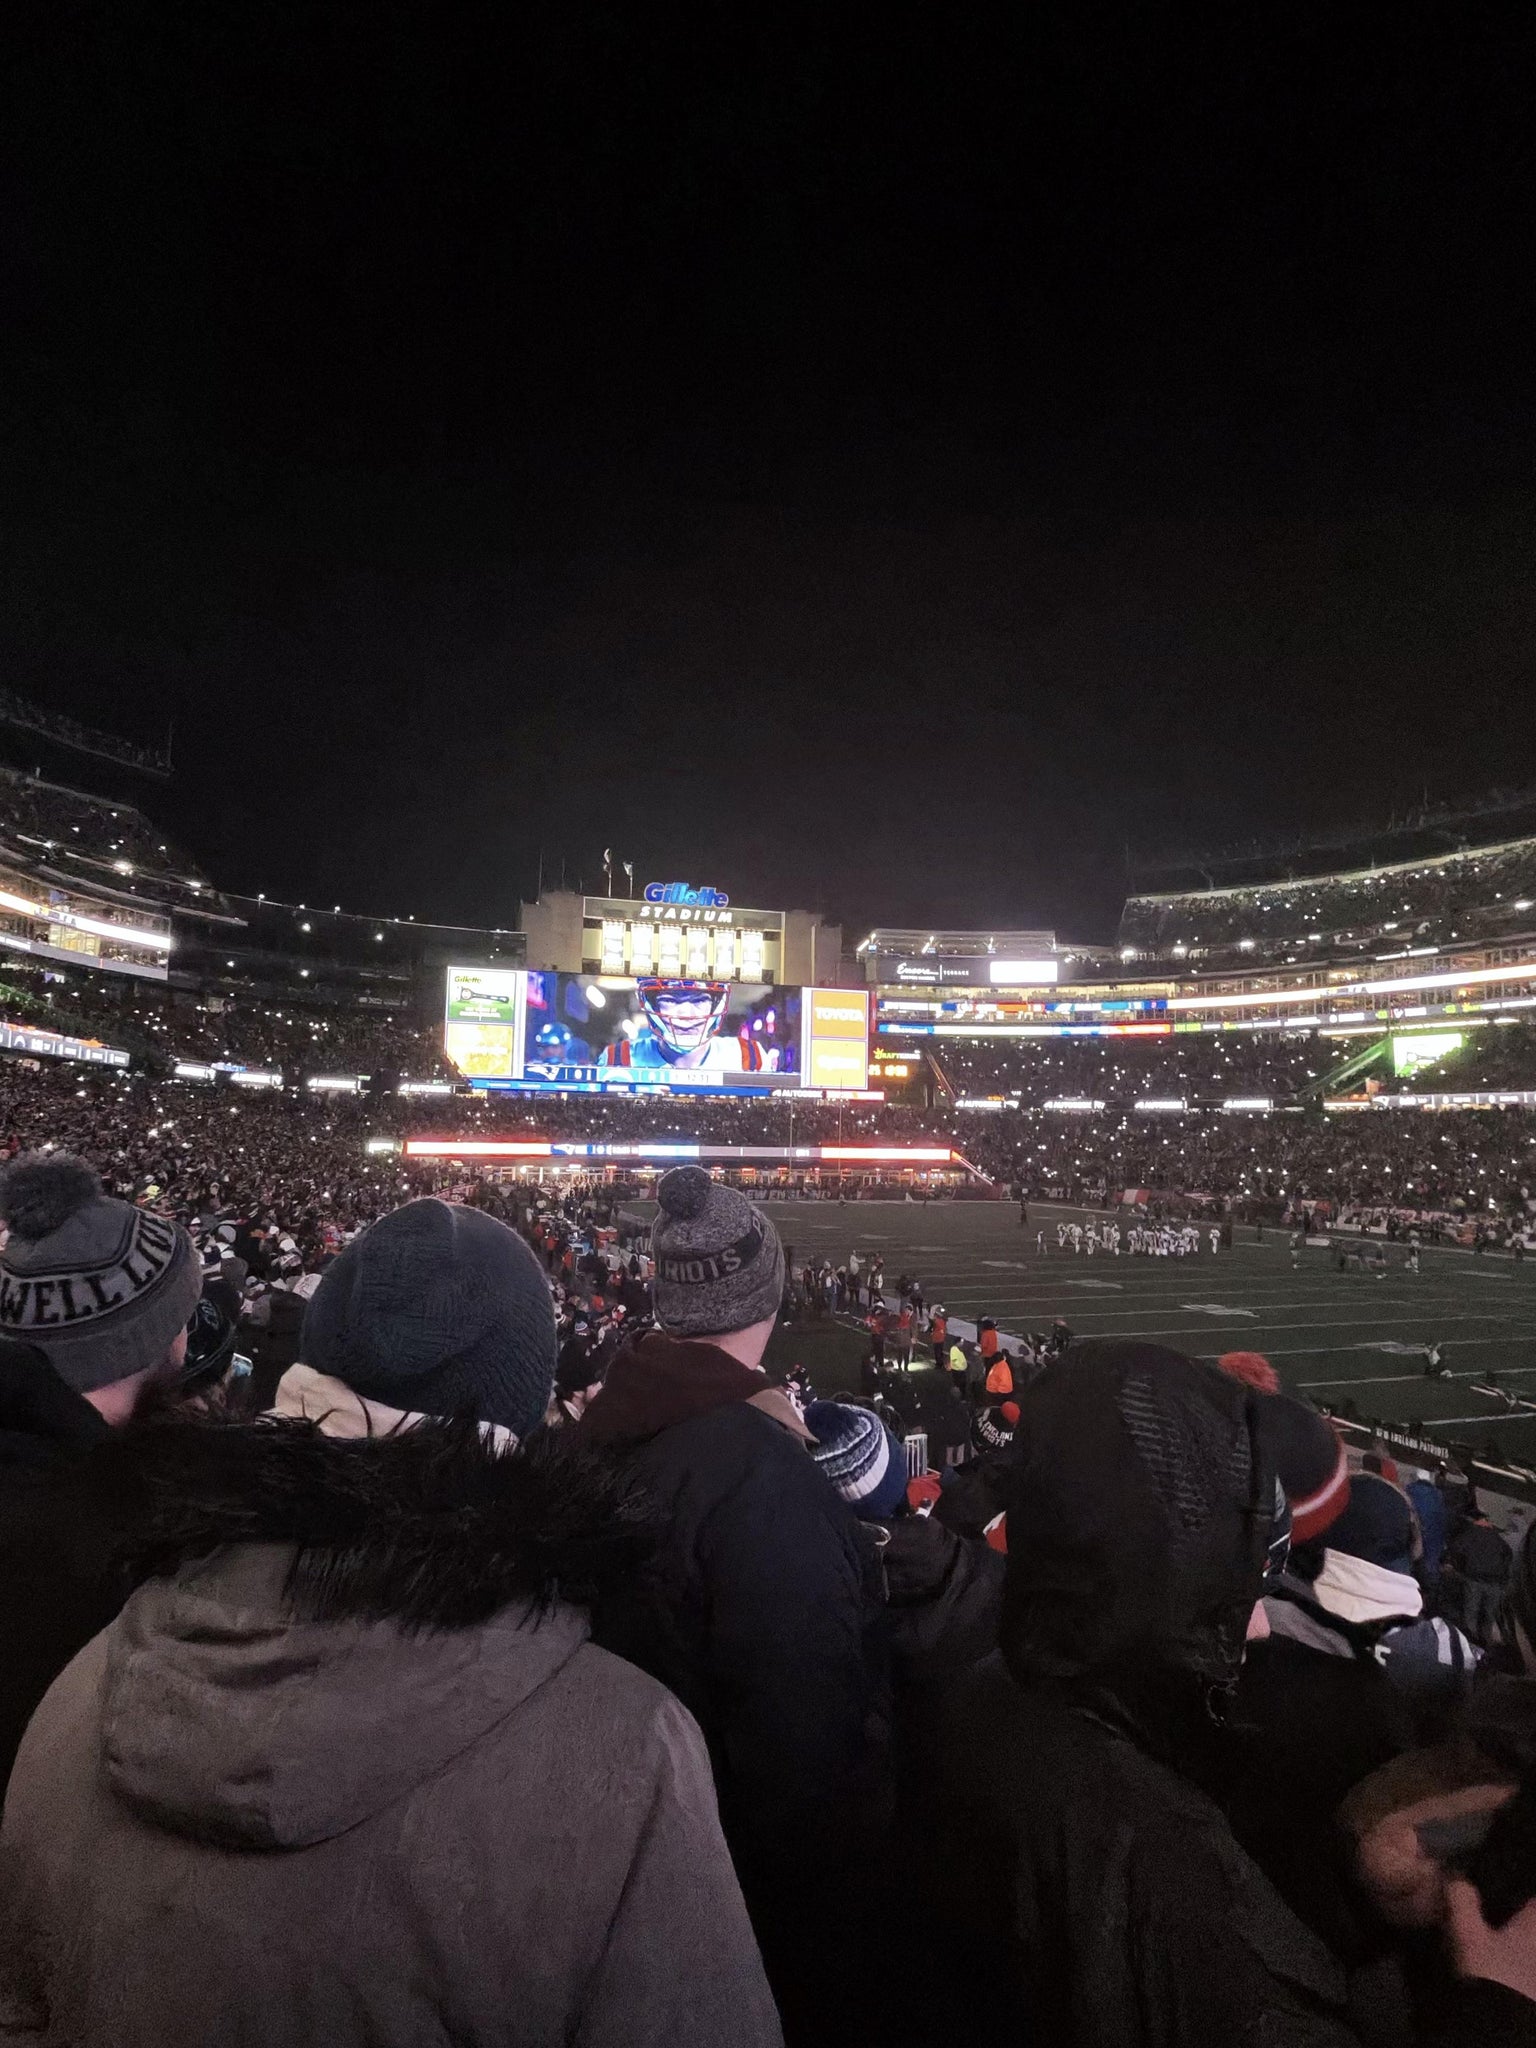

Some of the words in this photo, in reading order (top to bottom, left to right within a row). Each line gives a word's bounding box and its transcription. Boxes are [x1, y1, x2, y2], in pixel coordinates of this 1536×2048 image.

[644, 882, 729, 908] Gillette
[640, 906, 733, 923] STADIUM
[455, 976, 482, 984] Gillette
[874, 1050, 921, 1060] DRAFT
